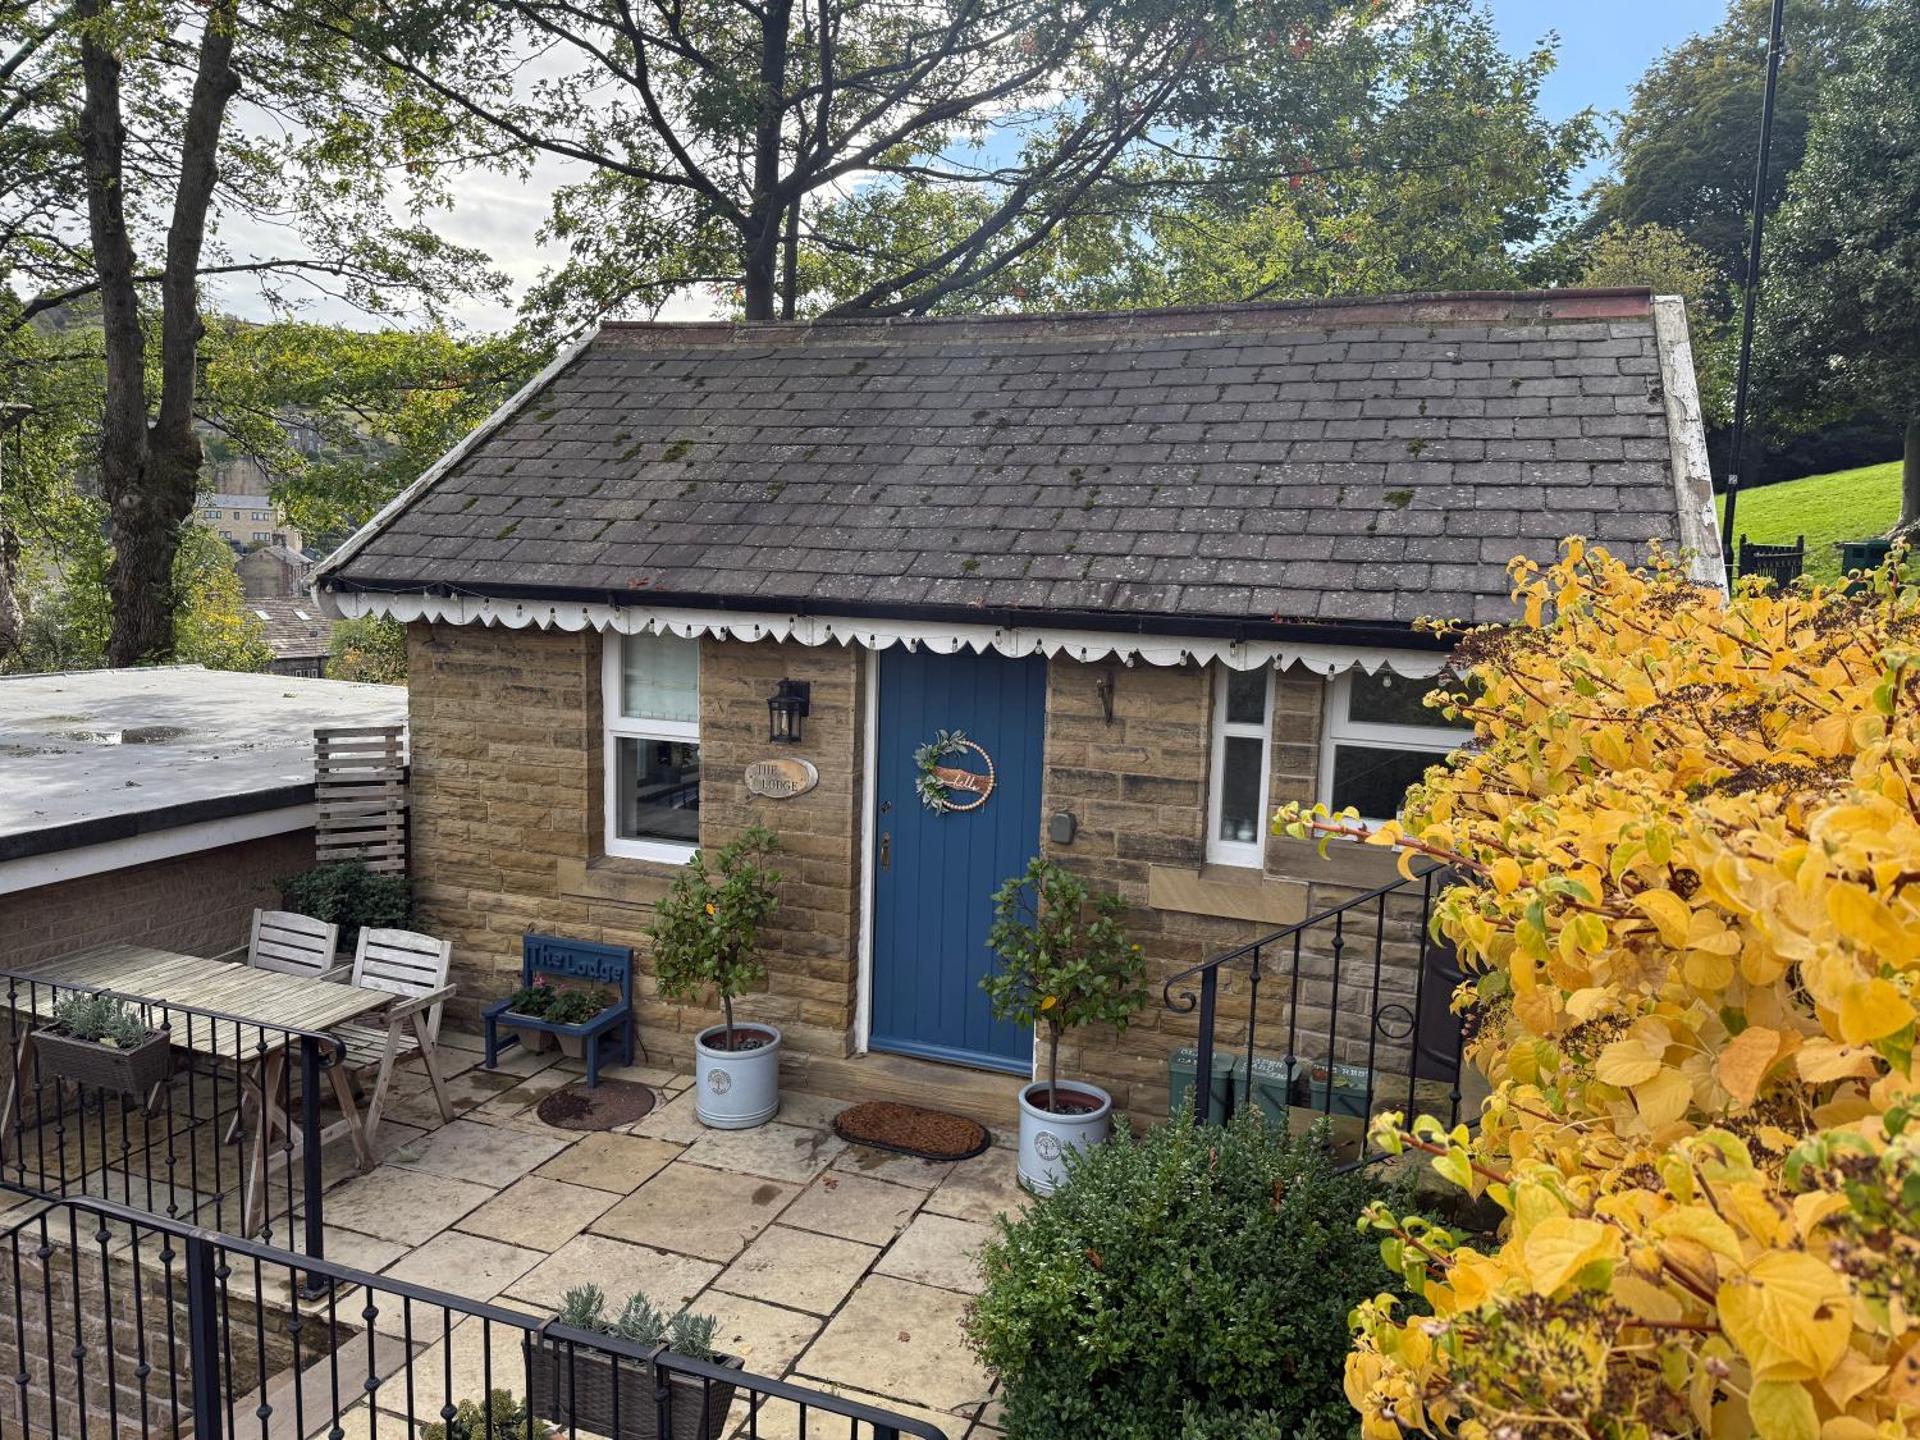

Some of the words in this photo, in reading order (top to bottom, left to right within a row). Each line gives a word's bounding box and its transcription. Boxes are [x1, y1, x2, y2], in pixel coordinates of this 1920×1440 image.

[757, 764, 779, 775] THE
[761, 779, 799, 792] LODGE
[526, 945, 565, 968] The
[567, 953, 625, 983] Lodge
